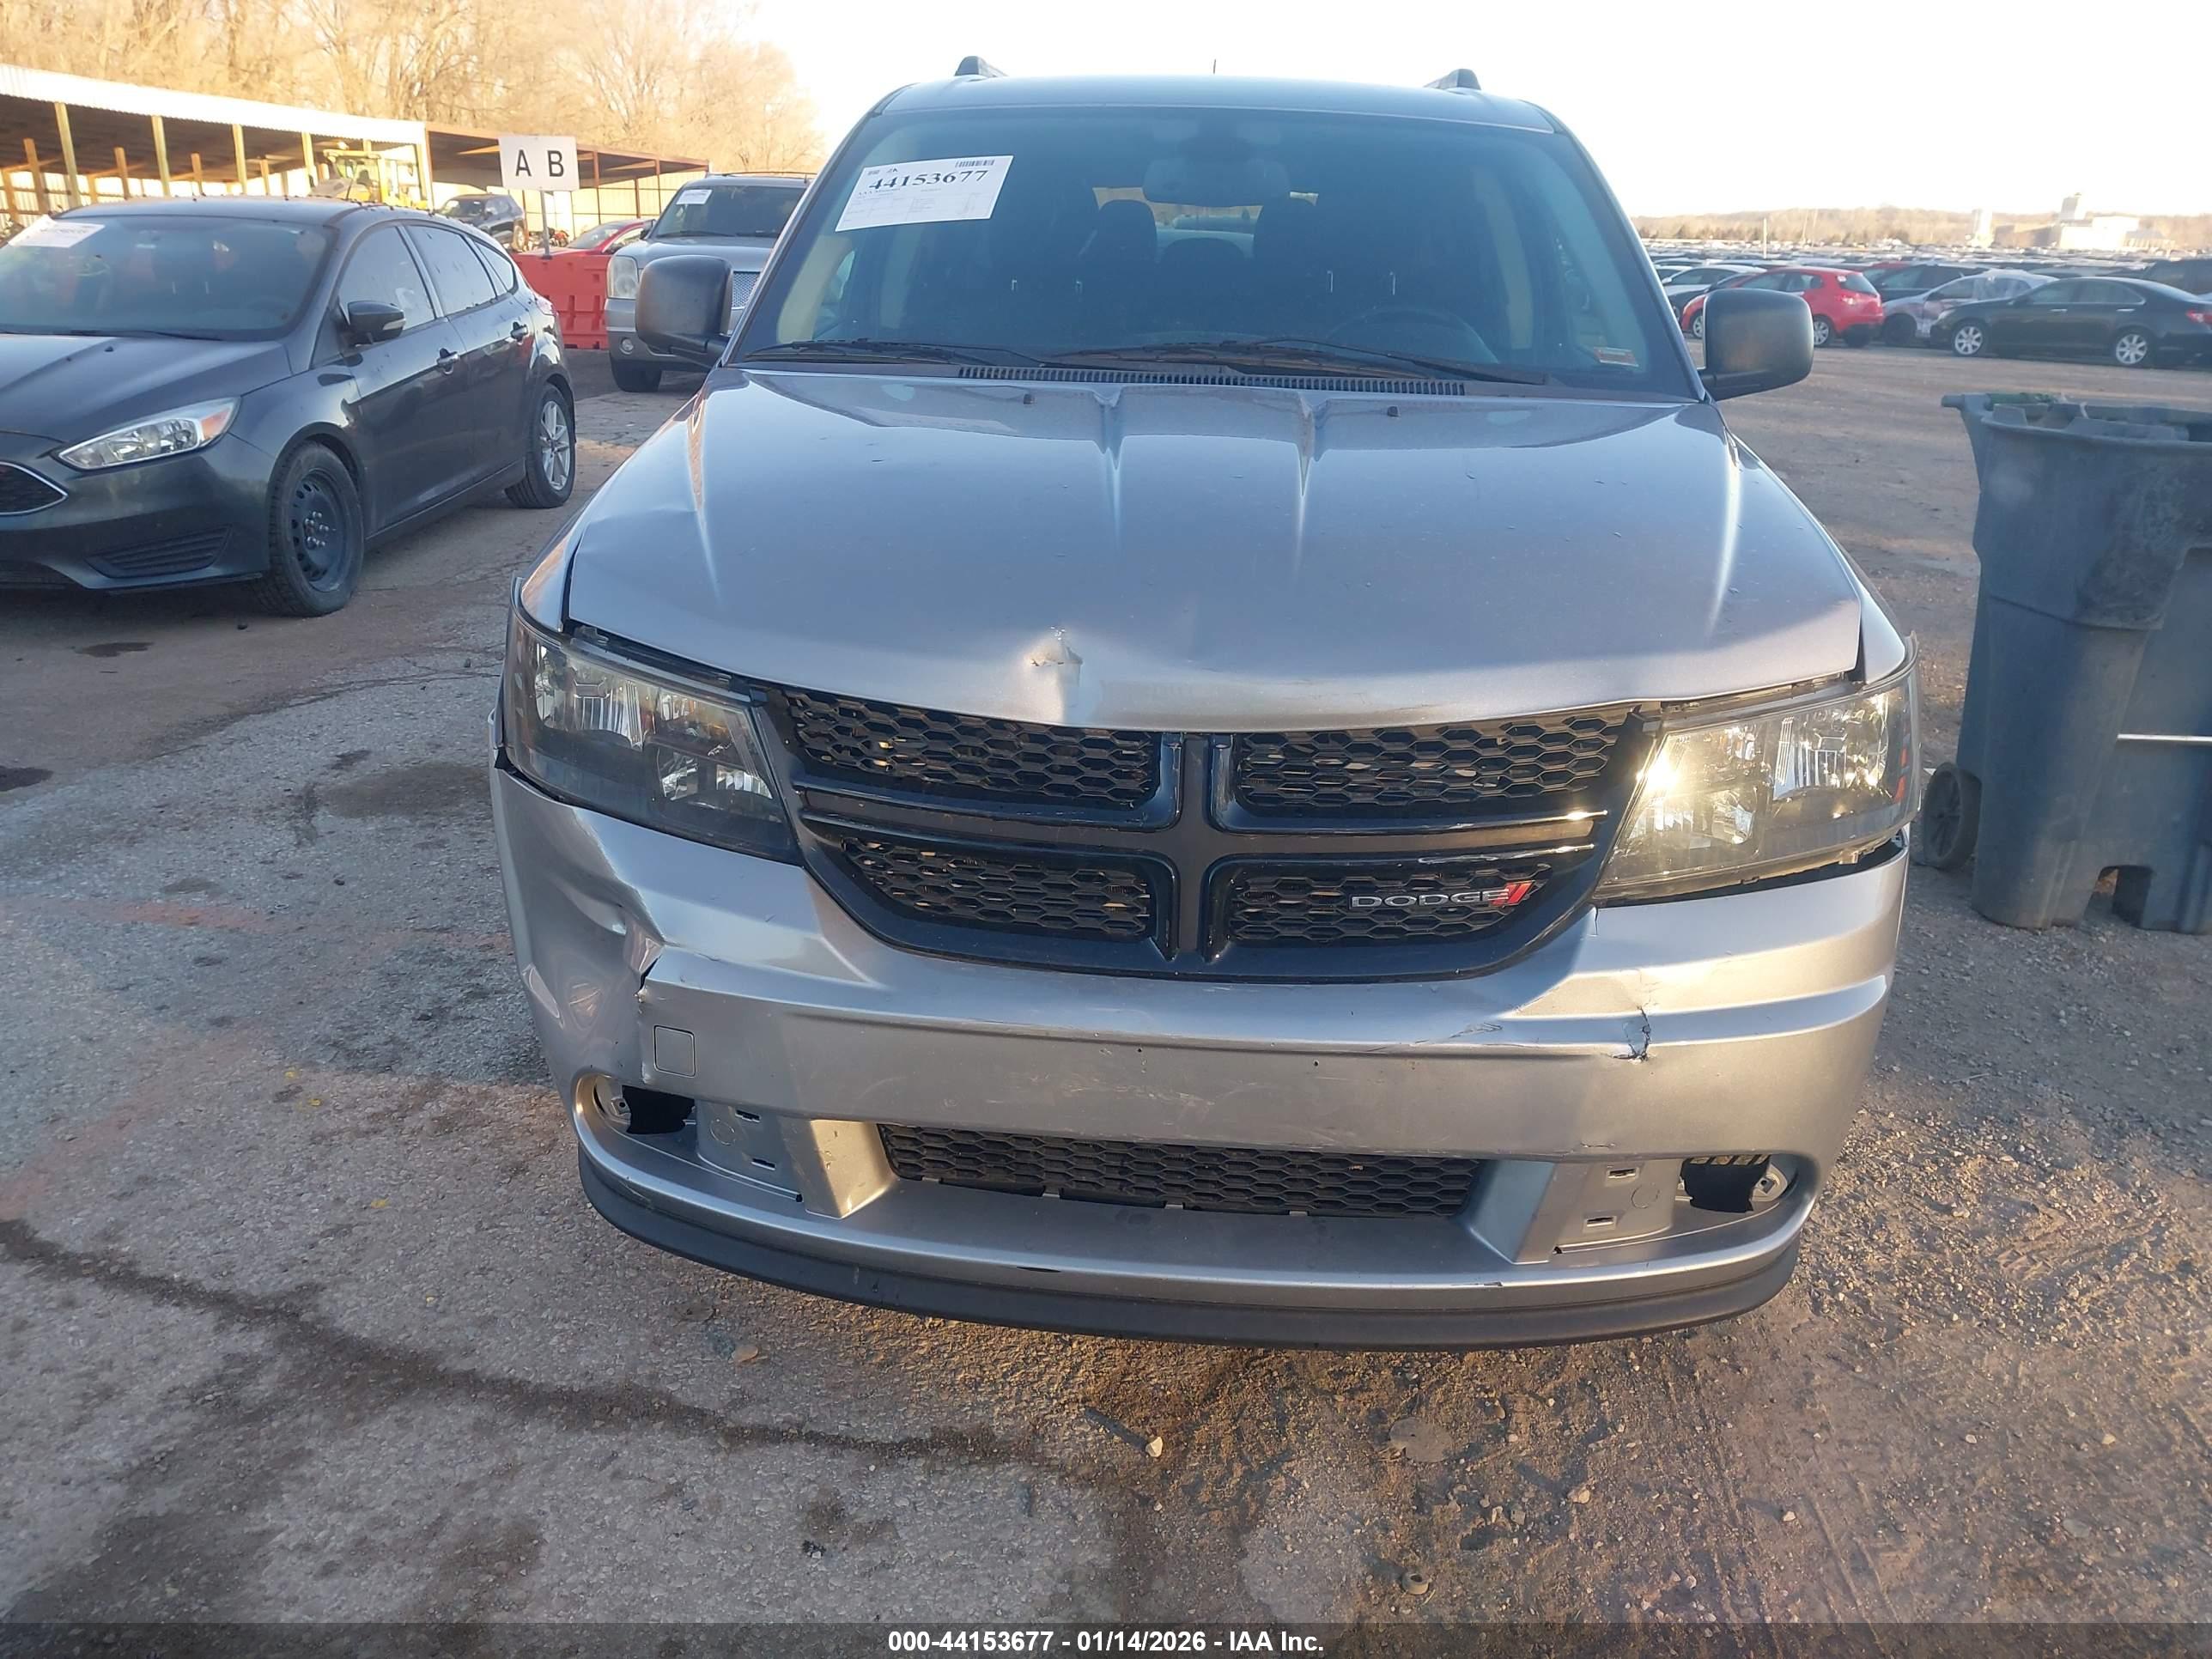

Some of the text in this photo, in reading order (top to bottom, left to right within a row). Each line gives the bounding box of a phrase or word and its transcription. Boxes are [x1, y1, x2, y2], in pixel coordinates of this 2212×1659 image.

[515, 149, 564, 177] A B
[868, 170, 989, 190] 44153677
[1351, 888, 1510, 908] DODGE
